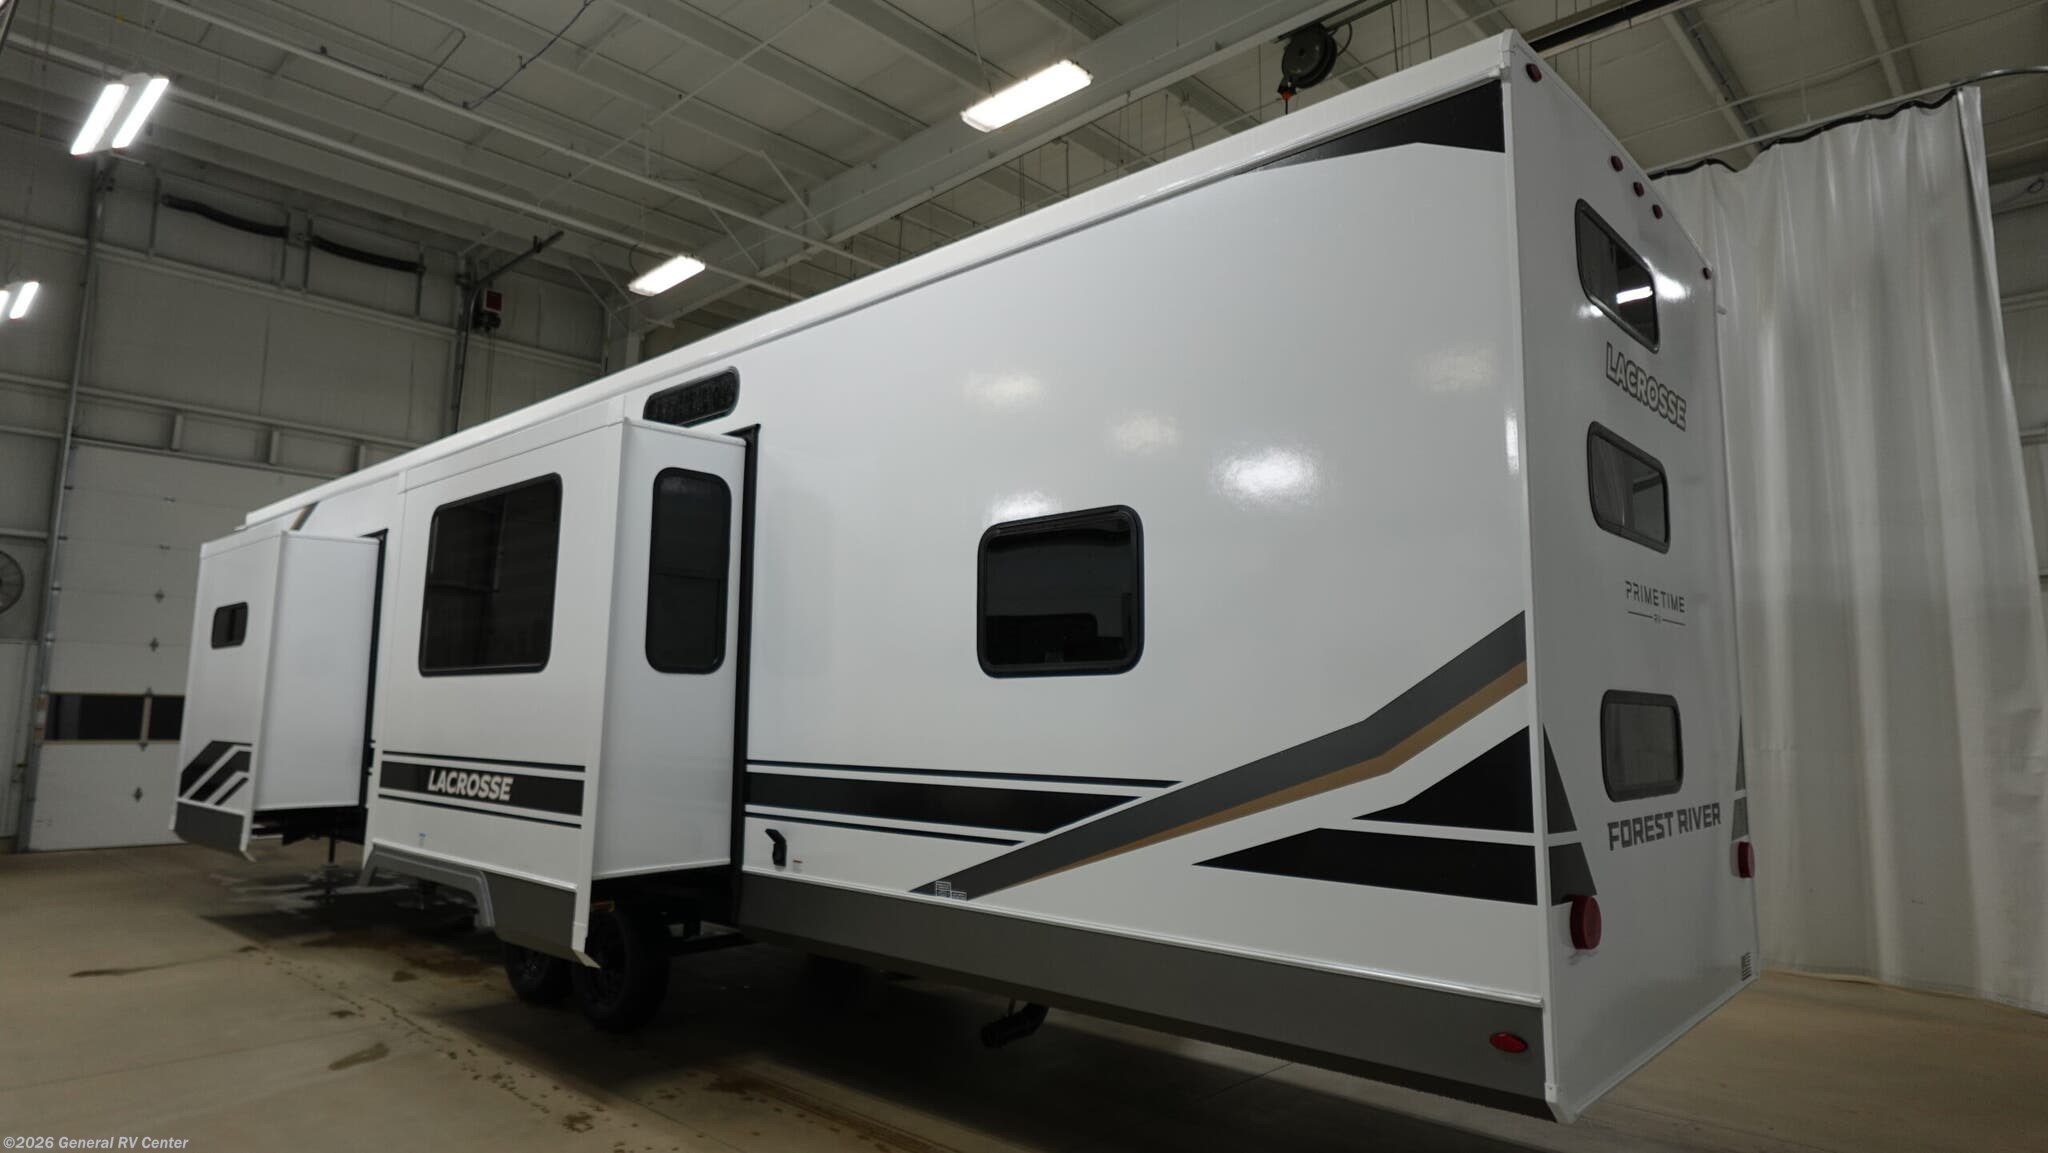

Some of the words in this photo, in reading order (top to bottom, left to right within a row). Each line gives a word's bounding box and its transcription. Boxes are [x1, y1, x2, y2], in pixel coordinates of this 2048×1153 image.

[1606, 341, 1687, 432] LACROSSE
[1625, 580, 1685, 613] PRIMETIME
[427, 769, 514, 801] LACROSSE
[1607, 811, 1674, 851] FOREST
[1677, 802, 1722, 834] RIVER
